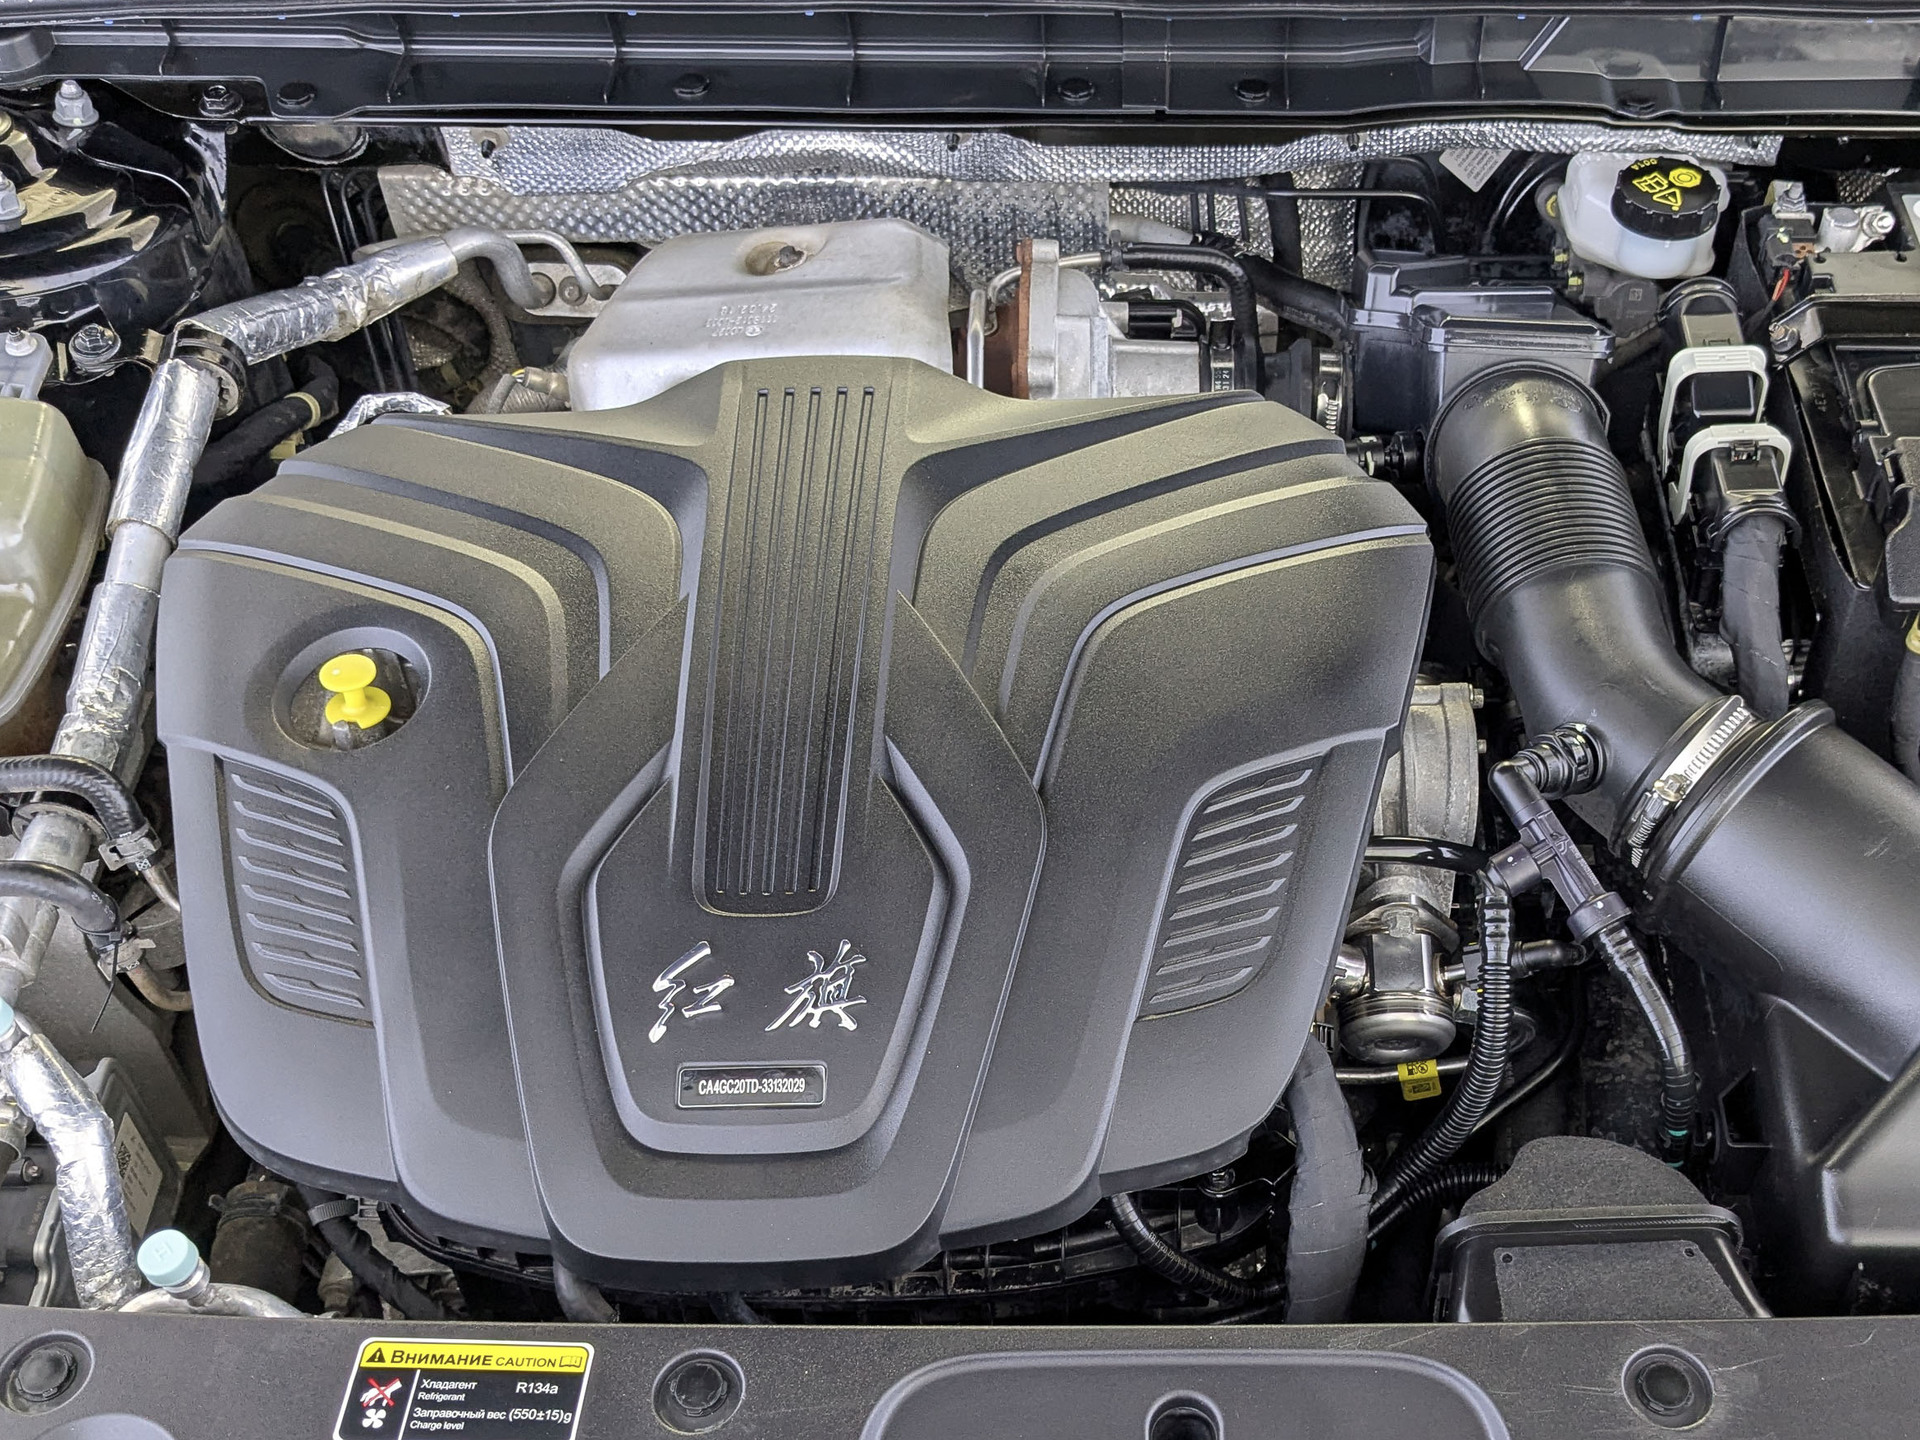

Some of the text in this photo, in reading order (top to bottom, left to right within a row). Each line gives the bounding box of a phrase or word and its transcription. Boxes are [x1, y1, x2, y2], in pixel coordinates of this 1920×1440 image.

[648, 938, 868, 1044] 红旗
[698, 1077, 806, 1096] CA4GC20TD-33132029
[495, 1357, 557, 1368] CAUTION
[420, 1379, 559, 1395] Хладагент R134a
[417, 1392, 465, 1402] Refrigerant
[412, 1407, 573, 1424] Заправочный вес (550±15)g
[409, 1420, 464, 1431] Charge level
